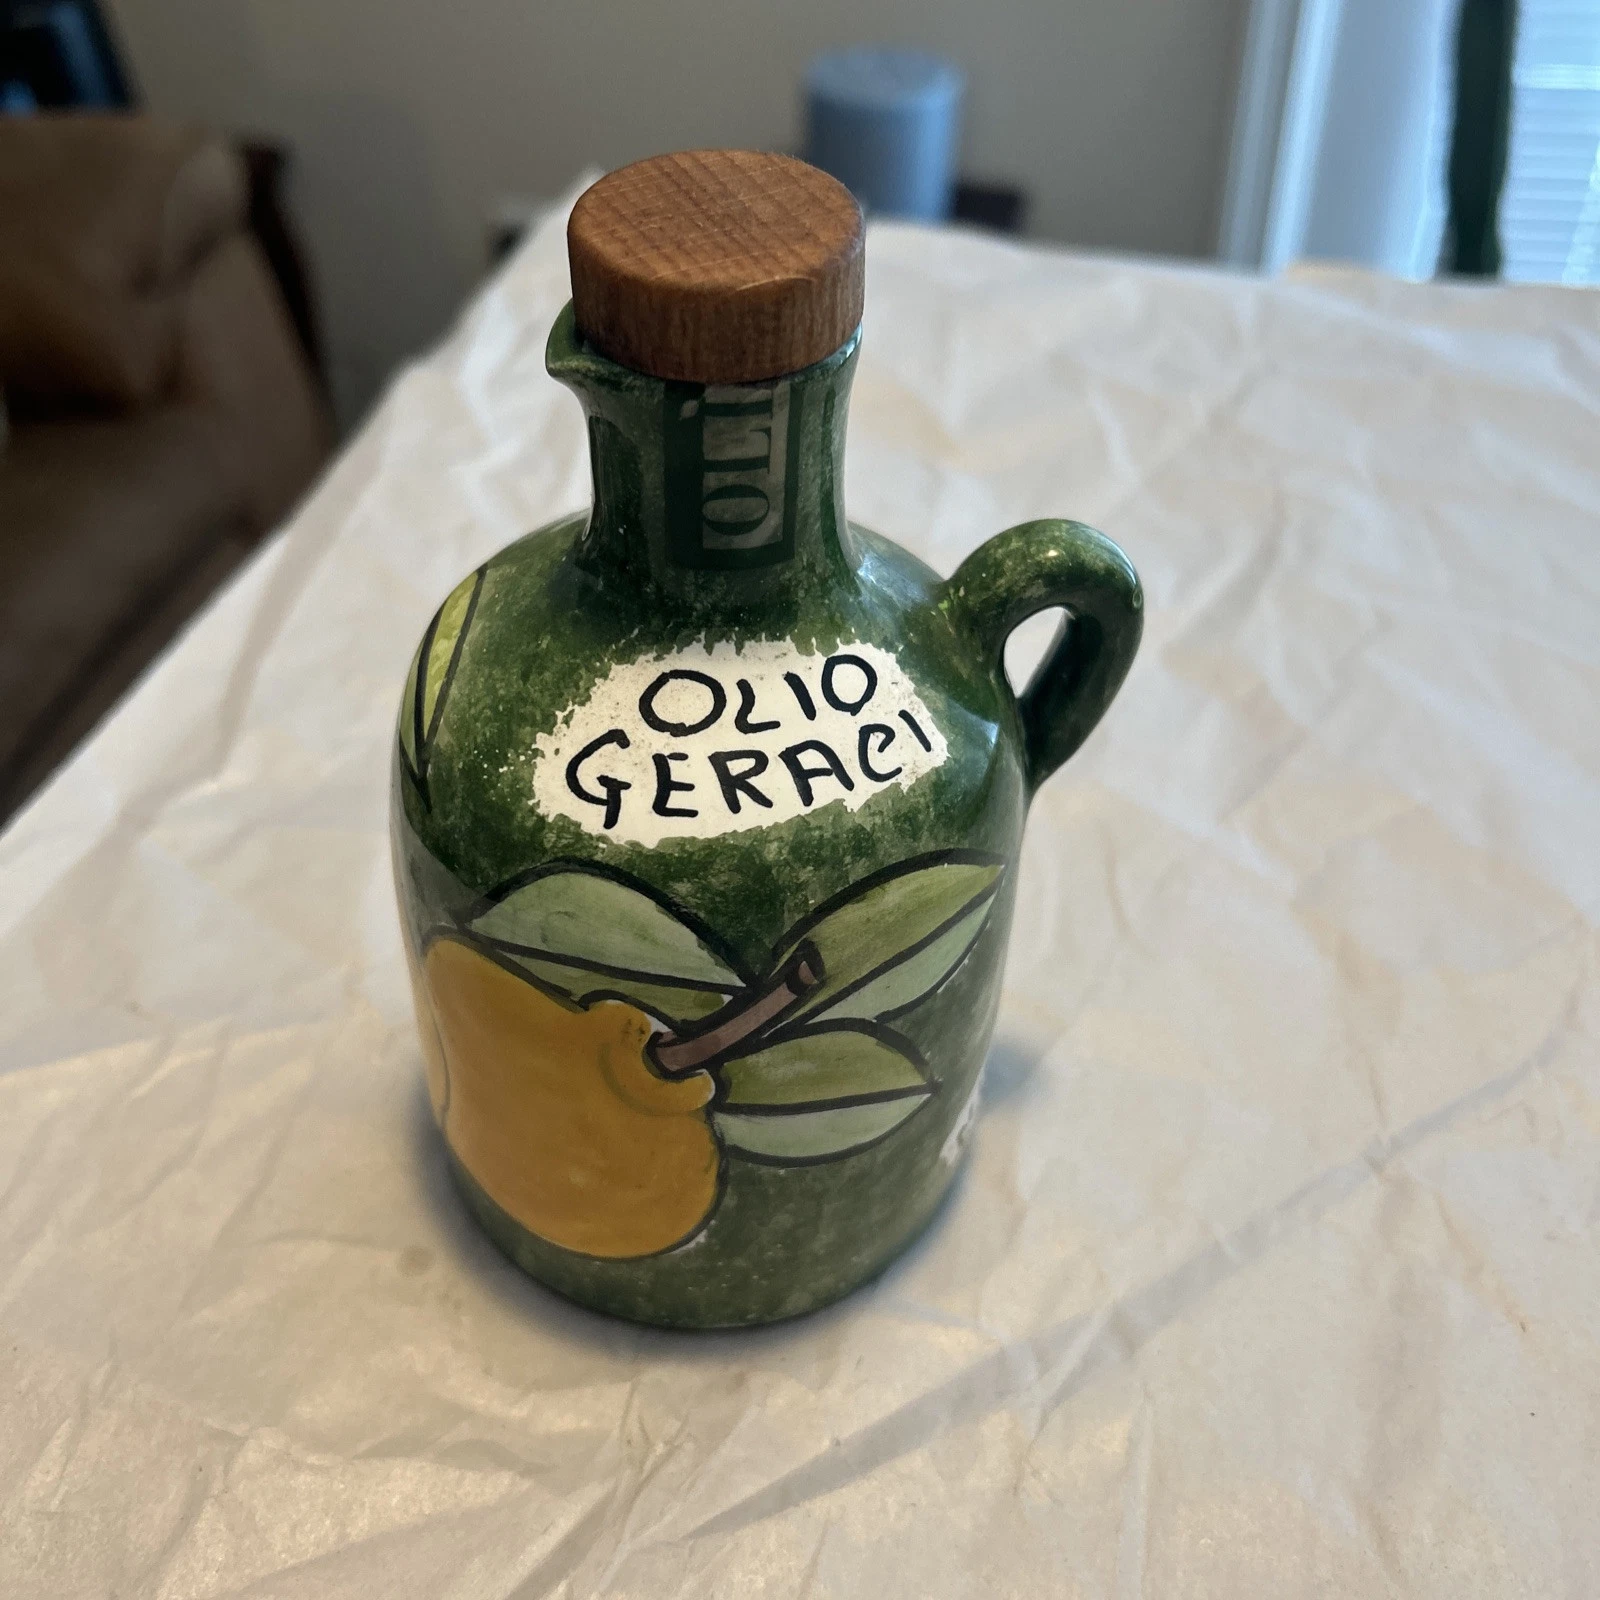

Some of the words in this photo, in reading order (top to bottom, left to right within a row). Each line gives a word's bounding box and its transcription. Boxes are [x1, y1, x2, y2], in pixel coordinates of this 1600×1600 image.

[700, 386, 774, 536] OLI
[639, 655, 878, 737] OLIO
[566, 711, 931, 829] GERACI
